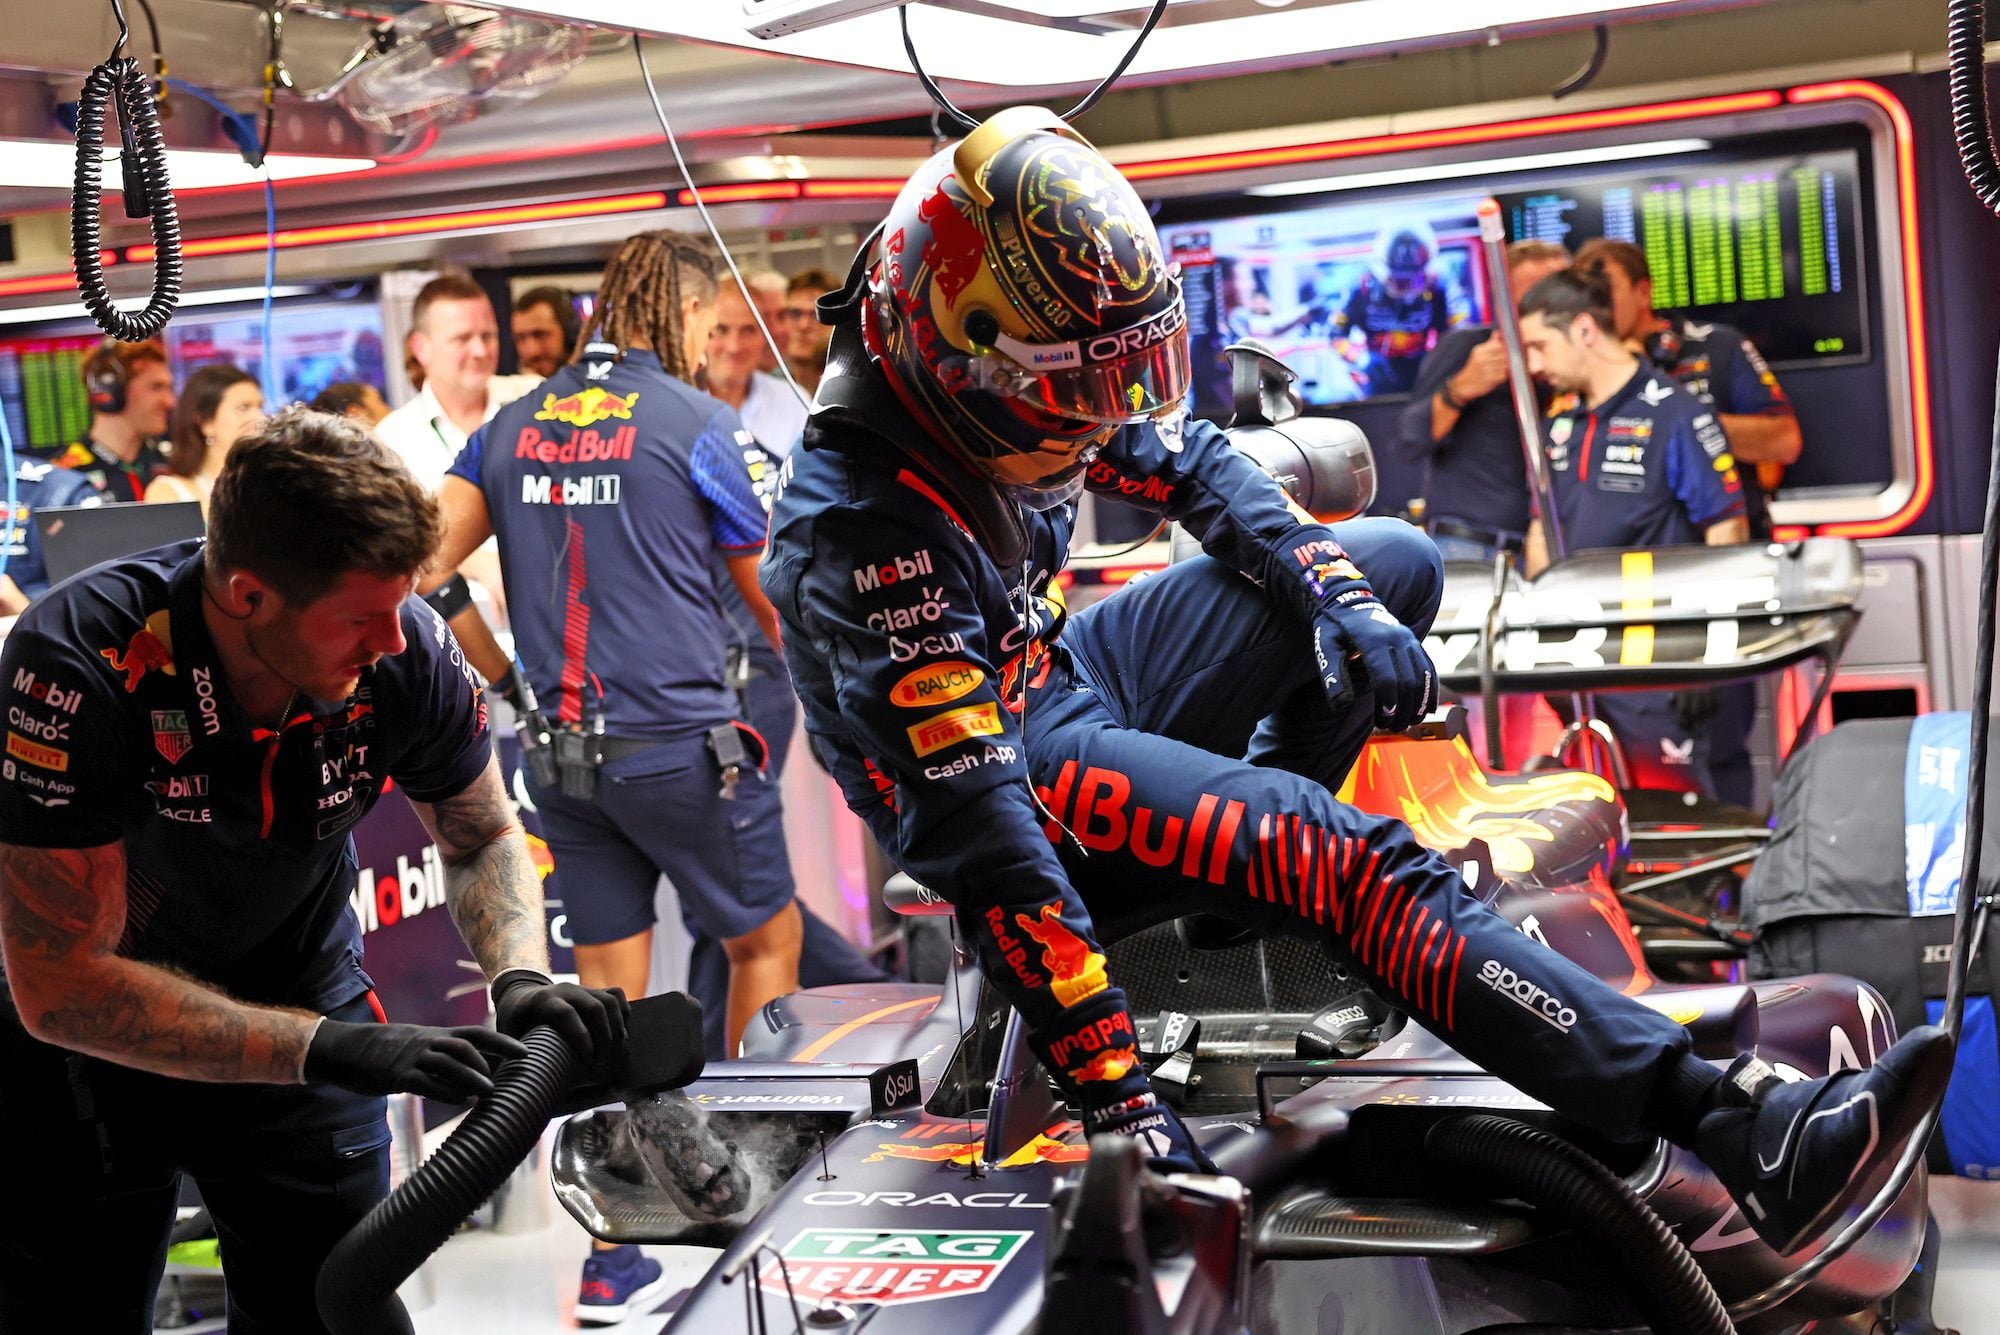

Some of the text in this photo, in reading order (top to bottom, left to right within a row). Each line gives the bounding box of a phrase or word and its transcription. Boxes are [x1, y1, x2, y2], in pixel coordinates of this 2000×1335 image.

[1034, 353, 1063, 364] Mobil
[522, 475, 593, 505] Mobil
[853, 550, 933, 593] Mobil
[867, 590, 947, 633] Claro
[1336, 589, 1373, 604] obil
[13, 667, 83, 714] Mobil
[915, 667, 974, 698] RAUCH
[192, 666, 220, 736] zoom
[9, 706, 62, 741] Claro
[155, 714, 189, 731] TAG
[917, 709, 994, 750] PIRELLI
[11, 737, 63, 768] PIRELLI
[156, 734, 193, 760] HEUER
[924, 744, 1018, 781] Cash App
[20, 772, 76, 795] Cash App
[158, 807, 213, 823] ACLE
[1036, 759, 1246, 885] dBull
[350, 843, 447, 936] Mobil
[1477, 959, 1578, 1034] sparco
[1325, 1005, 1368, 1028] sparco
[1301, 1030, 1331, 1046] infinitum
[896, 1071, 914, 1097] Sui
[716, 1095, 845, 1104] Walmart
[1093, 1092, 1157, 1123] Mobil
[802, 1190, 1051, 1209] ORACL
[812, 1234, 1003, 1257] TAG
[772, 1265, 986, 1295] HEUER
